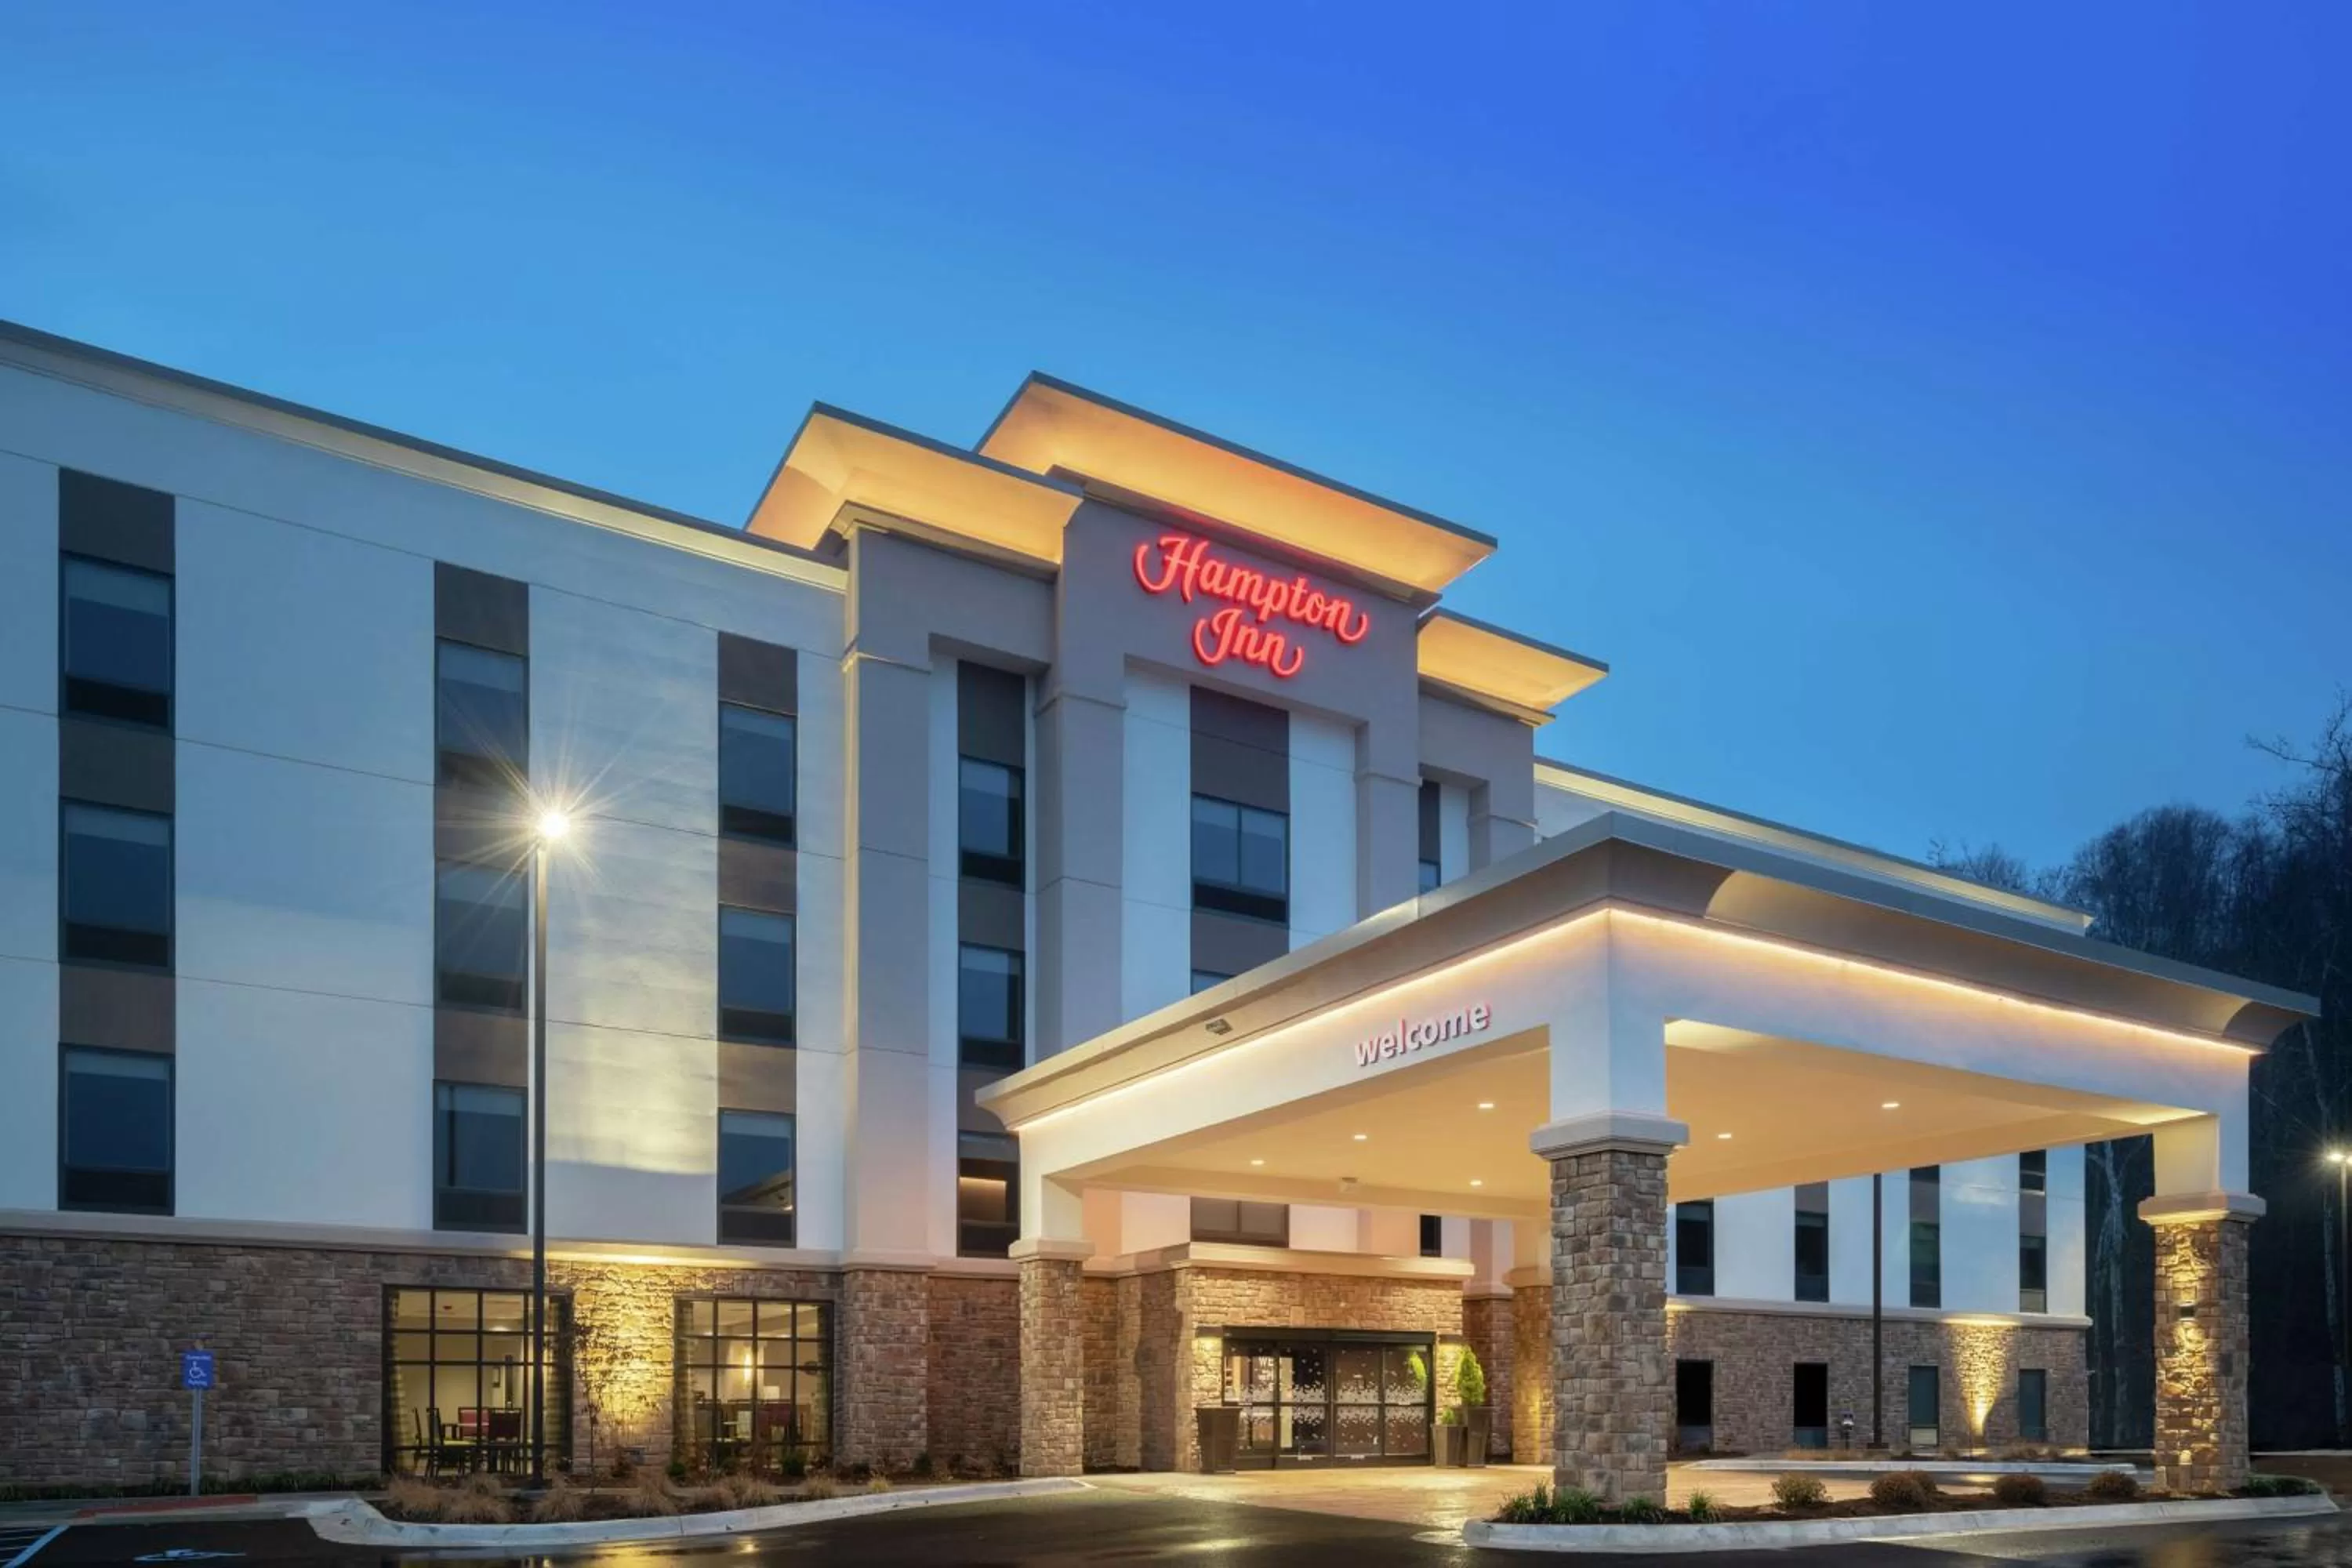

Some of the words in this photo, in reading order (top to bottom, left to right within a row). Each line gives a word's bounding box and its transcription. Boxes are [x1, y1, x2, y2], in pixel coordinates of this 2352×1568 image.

[1134, 535, 1369, 642] Hampton
[1193, 607, 1305, 677] Inn
[1355, 1001, 1490, 1066] welcome
